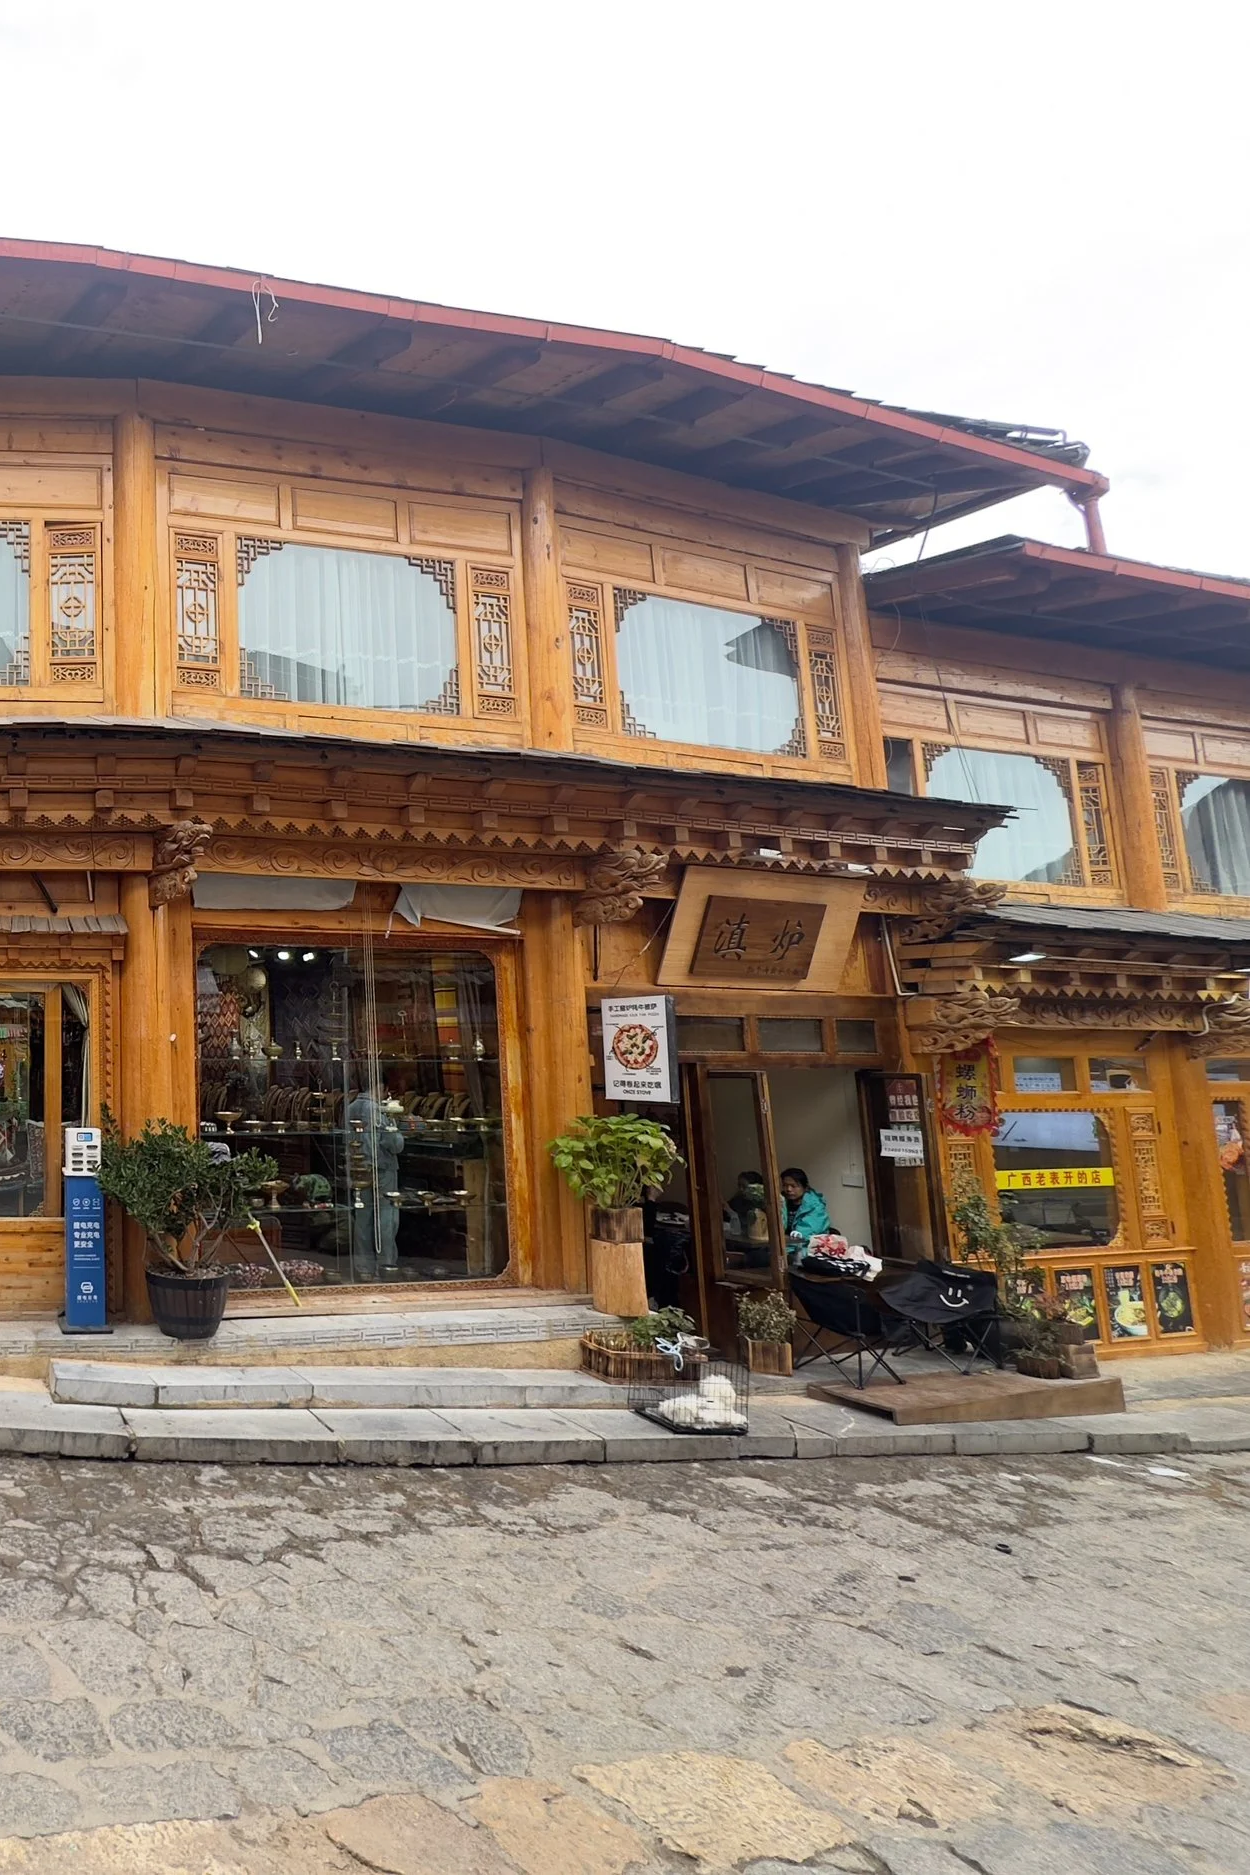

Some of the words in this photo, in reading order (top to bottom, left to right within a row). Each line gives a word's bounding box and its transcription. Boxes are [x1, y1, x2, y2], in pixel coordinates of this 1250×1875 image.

[713, 913, 805, 961] 滇炉
[1007, 1170, 1101, 1187] 广西老表开的店
